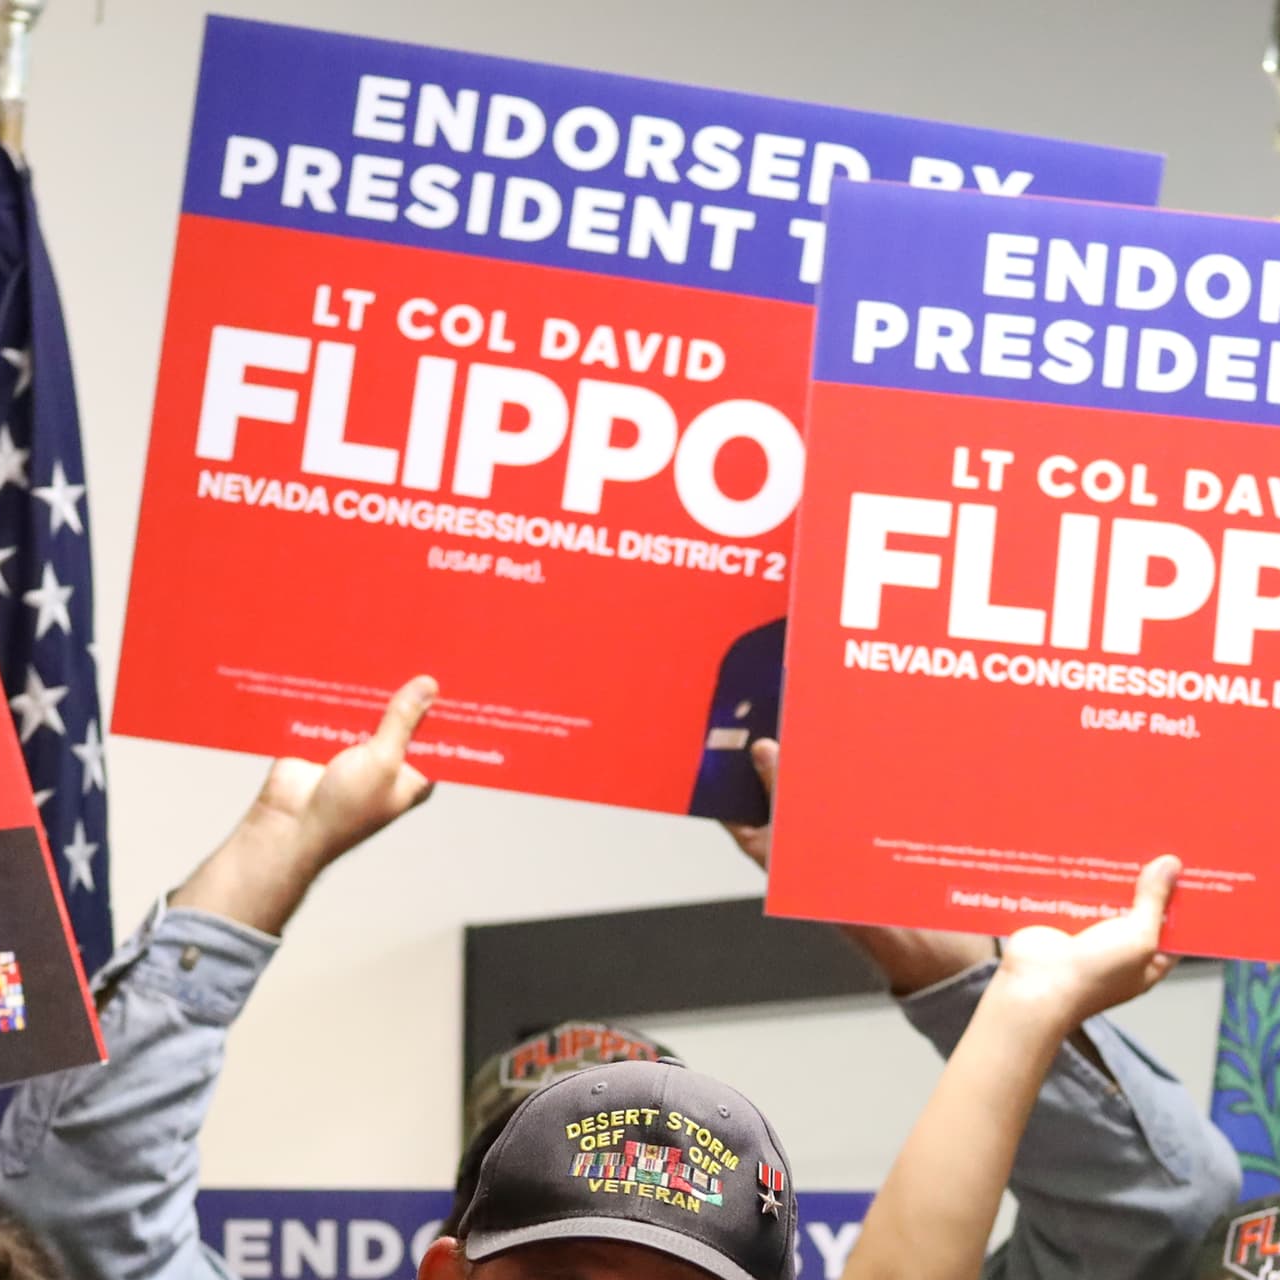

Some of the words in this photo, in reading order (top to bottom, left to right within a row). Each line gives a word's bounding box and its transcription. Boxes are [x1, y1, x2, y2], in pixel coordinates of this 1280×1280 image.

[352, 74, 873, 207] ENDORSED
[219, 135, 757, 272] PRESIDENT
[312, 284, 376, 332] LT
[396, 297, 516, 354] COL
[539, 317, 726, 383] DAVID
[195, 324, 808, 539] FLIPPO
[950, 445, 1016, 493] LT
[1036, 453, 1159, 508] COL
[197, 469, 330, 516] NEVADA
[332, 489, 615, 557] CONGRESSIONAL
[617, 529, 763, 577] DISTRICT
[762, 551, 787, 582] 2
[428, 546, 492, 574] (USAF
[843, 638, 980, 681] NEVADA
[981, 652, 1270, 709] CONGRESSIONAL
[1080, 705, 1146, 733] (USAF
[566, 1107, 660, 1141] DESERT
[666, 1110, 742, 1173] STORM
[579, 1128, 626, 1152] OEF
[687, 1147, 723, 1178] OIF
[587, 1178, 702, 1215] VETERAN
